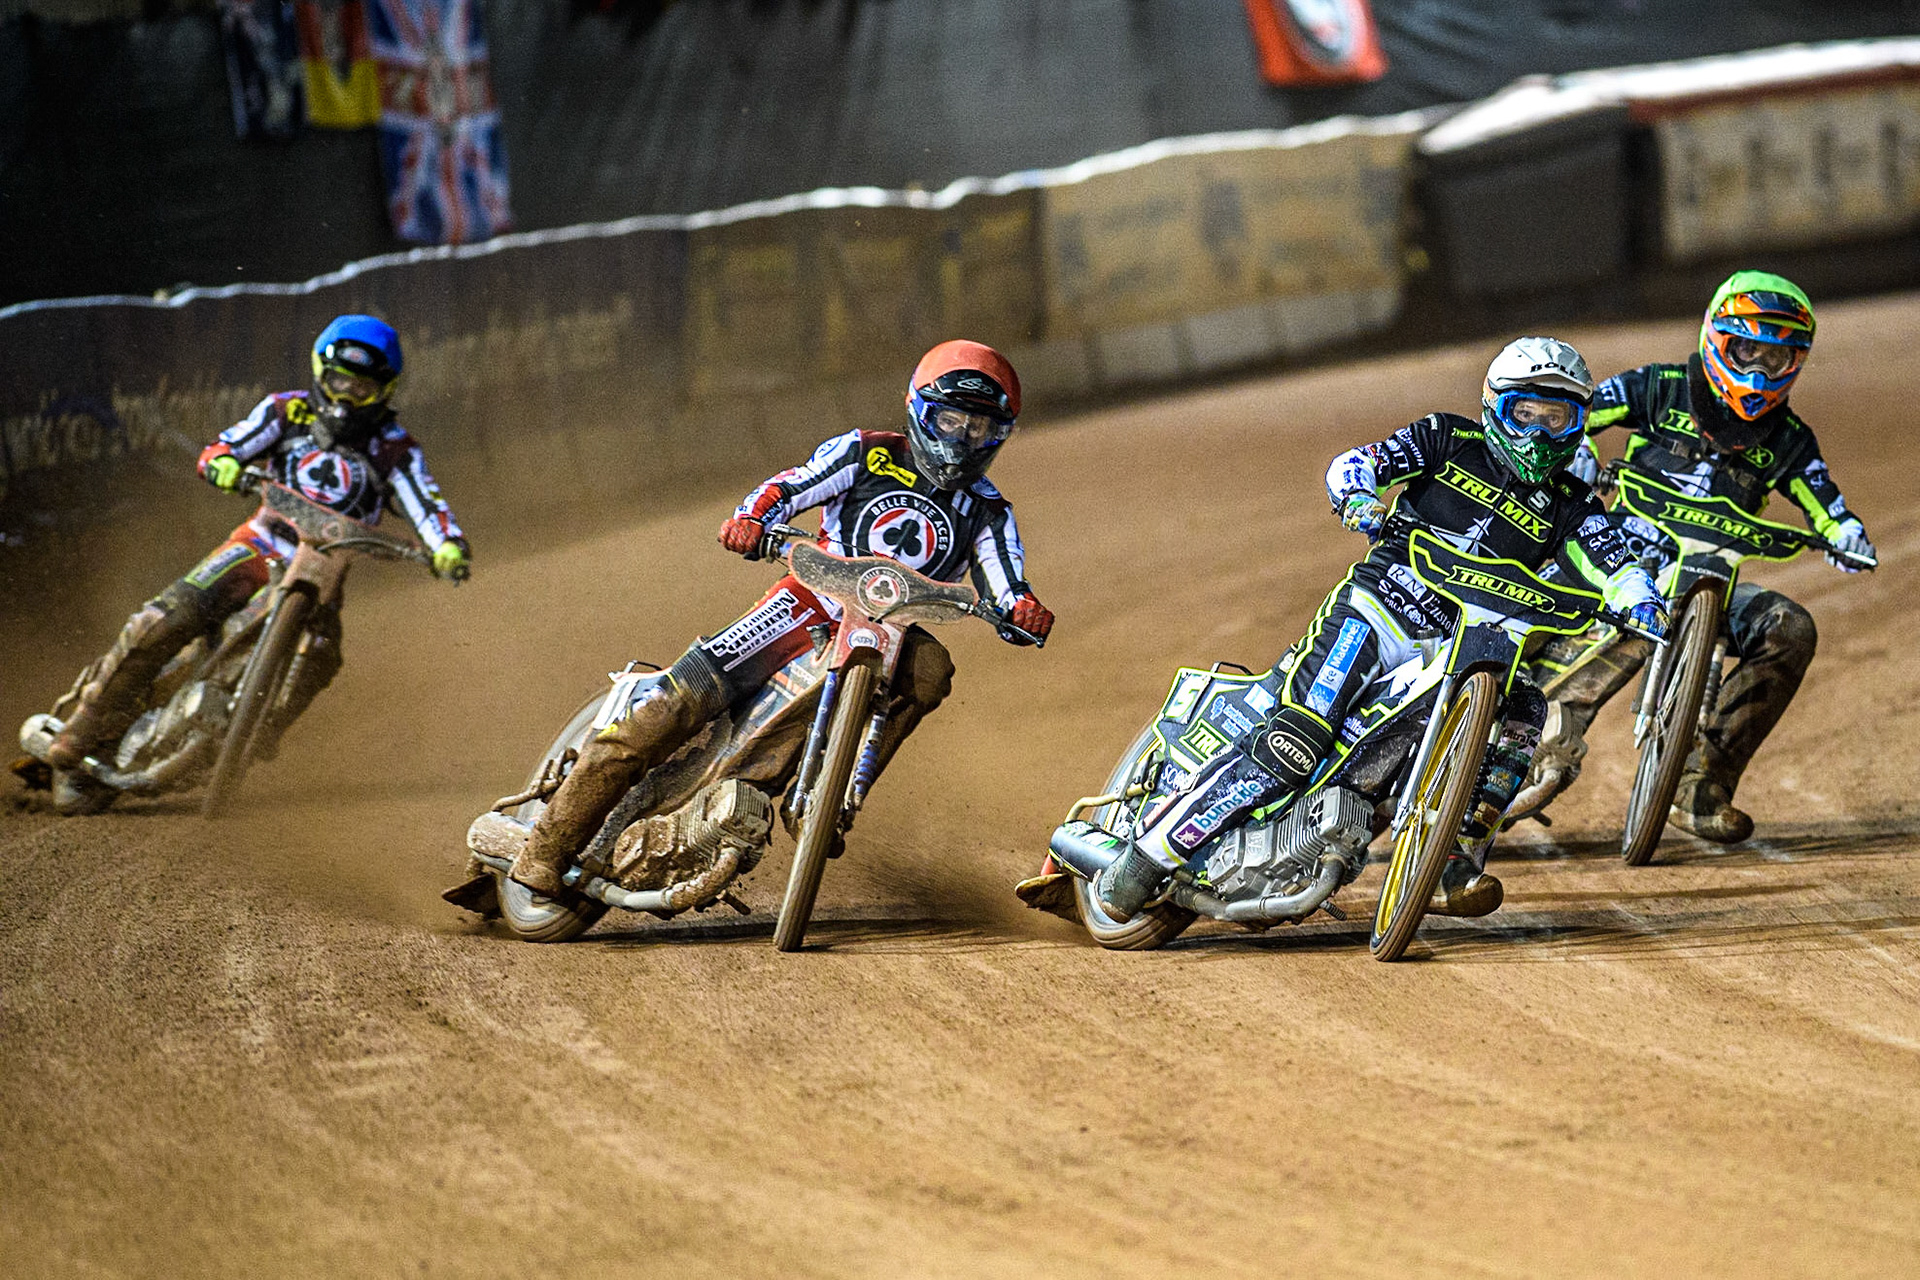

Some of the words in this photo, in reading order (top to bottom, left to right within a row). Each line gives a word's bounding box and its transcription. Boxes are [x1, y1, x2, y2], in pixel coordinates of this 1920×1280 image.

[1450, 470, 1501, 504] TRU
[1500, 500, 1547, 537] MIX
[1530, 489, 1550, 510] 5
[1673, 506, 1716, 526] TRU
[870, 497, 908, 517] BELLE
[914, 499, 937, 519] VUE
[934, 520, 948, 551] ACES
[1459, 570, 1504, 591] TRU
[1503, 584, 1549, 606] MIX
[1329, 622, 1361, 668] Machines
[1322, 669, 1337, 685] Ice
[1272, 735, 1315, 773] ORTEMA
